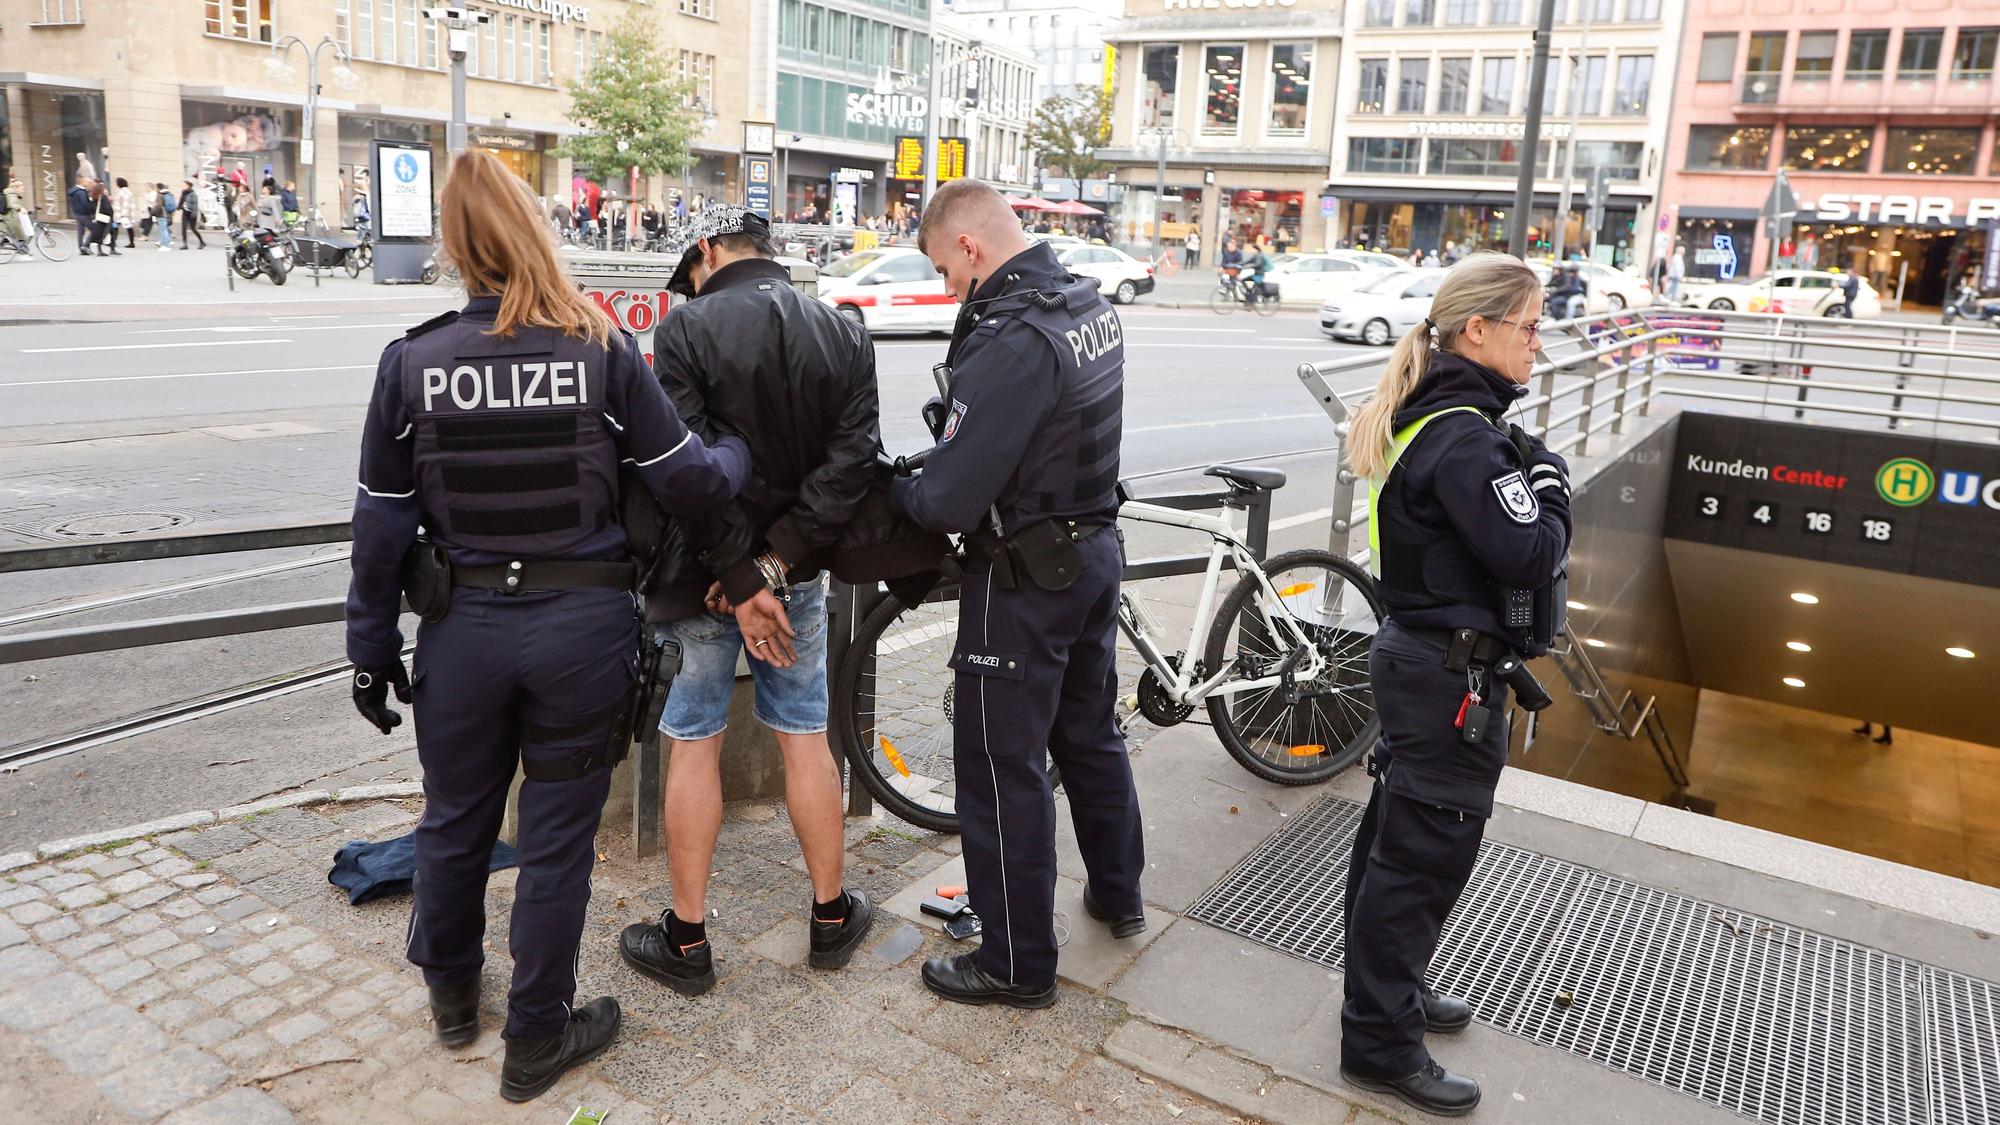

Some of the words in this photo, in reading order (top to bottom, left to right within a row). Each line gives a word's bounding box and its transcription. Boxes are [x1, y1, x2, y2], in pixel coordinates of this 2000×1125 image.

[1407, 121, 1506, 137] STARBUCKS
[395, 184, 417, 194] ZONE
[1794, 193, 1954, 225] -STAR
[585, 289, 672, 332] Köl
[1065, 311, 1122, 368] POLIZEI
[423, 361, 588, 412] POLIZEI
[1687, 454, 1769, 480] Kunden
[1771, 465, 1848, 489] Center
[1891, 468, 1918, 497] H
[1942, 473, 1980, 504] U
[1702, 497, 1719, 515] 3
[1753, 505, 1771, 524] 4
[1806, 512, 1832, 532] 16
[1863, 520, 1892, 541] 18
[967, 654, 1000, 668] POLIZEI
